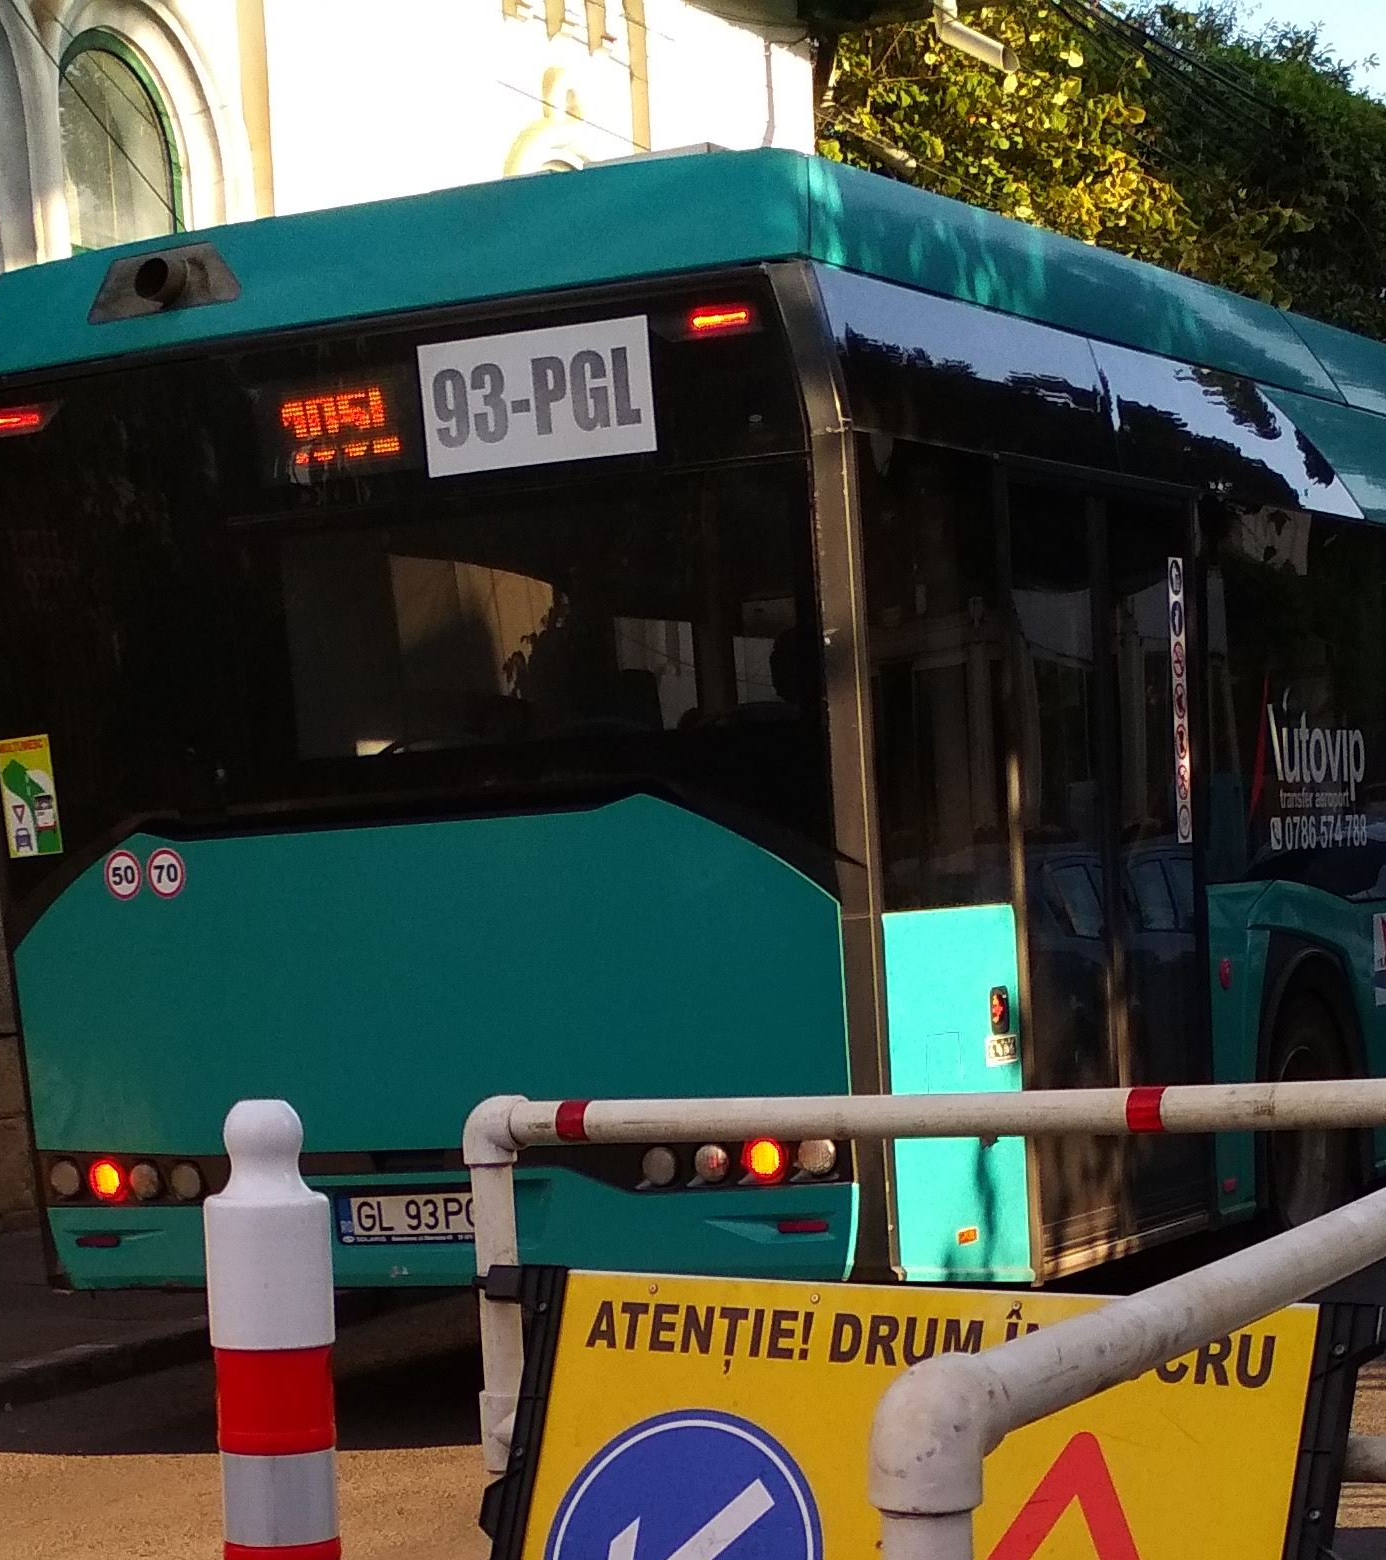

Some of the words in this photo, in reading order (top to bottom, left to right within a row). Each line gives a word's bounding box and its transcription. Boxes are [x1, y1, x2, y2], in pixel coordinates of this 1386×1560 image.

[433, 346, 643, 449] 93-PGL
[1279, 787, 1314, 809] transfer
[1285, 815, 1317, 851] 0786
[1319, 814, 1343, 849] 574
[1344, 813, 1368, 848] 788
[111, 865, 136, 886] 50
[153, 863, 179, 884] 70
[357, 1200, 395, 1233] GL
[405, 1199, 440, 1231] 93
[585, 1300, 815, 1375] ATENȚIE!
[828, 1312, 985, 1367] DRUM
[1004, 1300, 1041, 1342] Î
